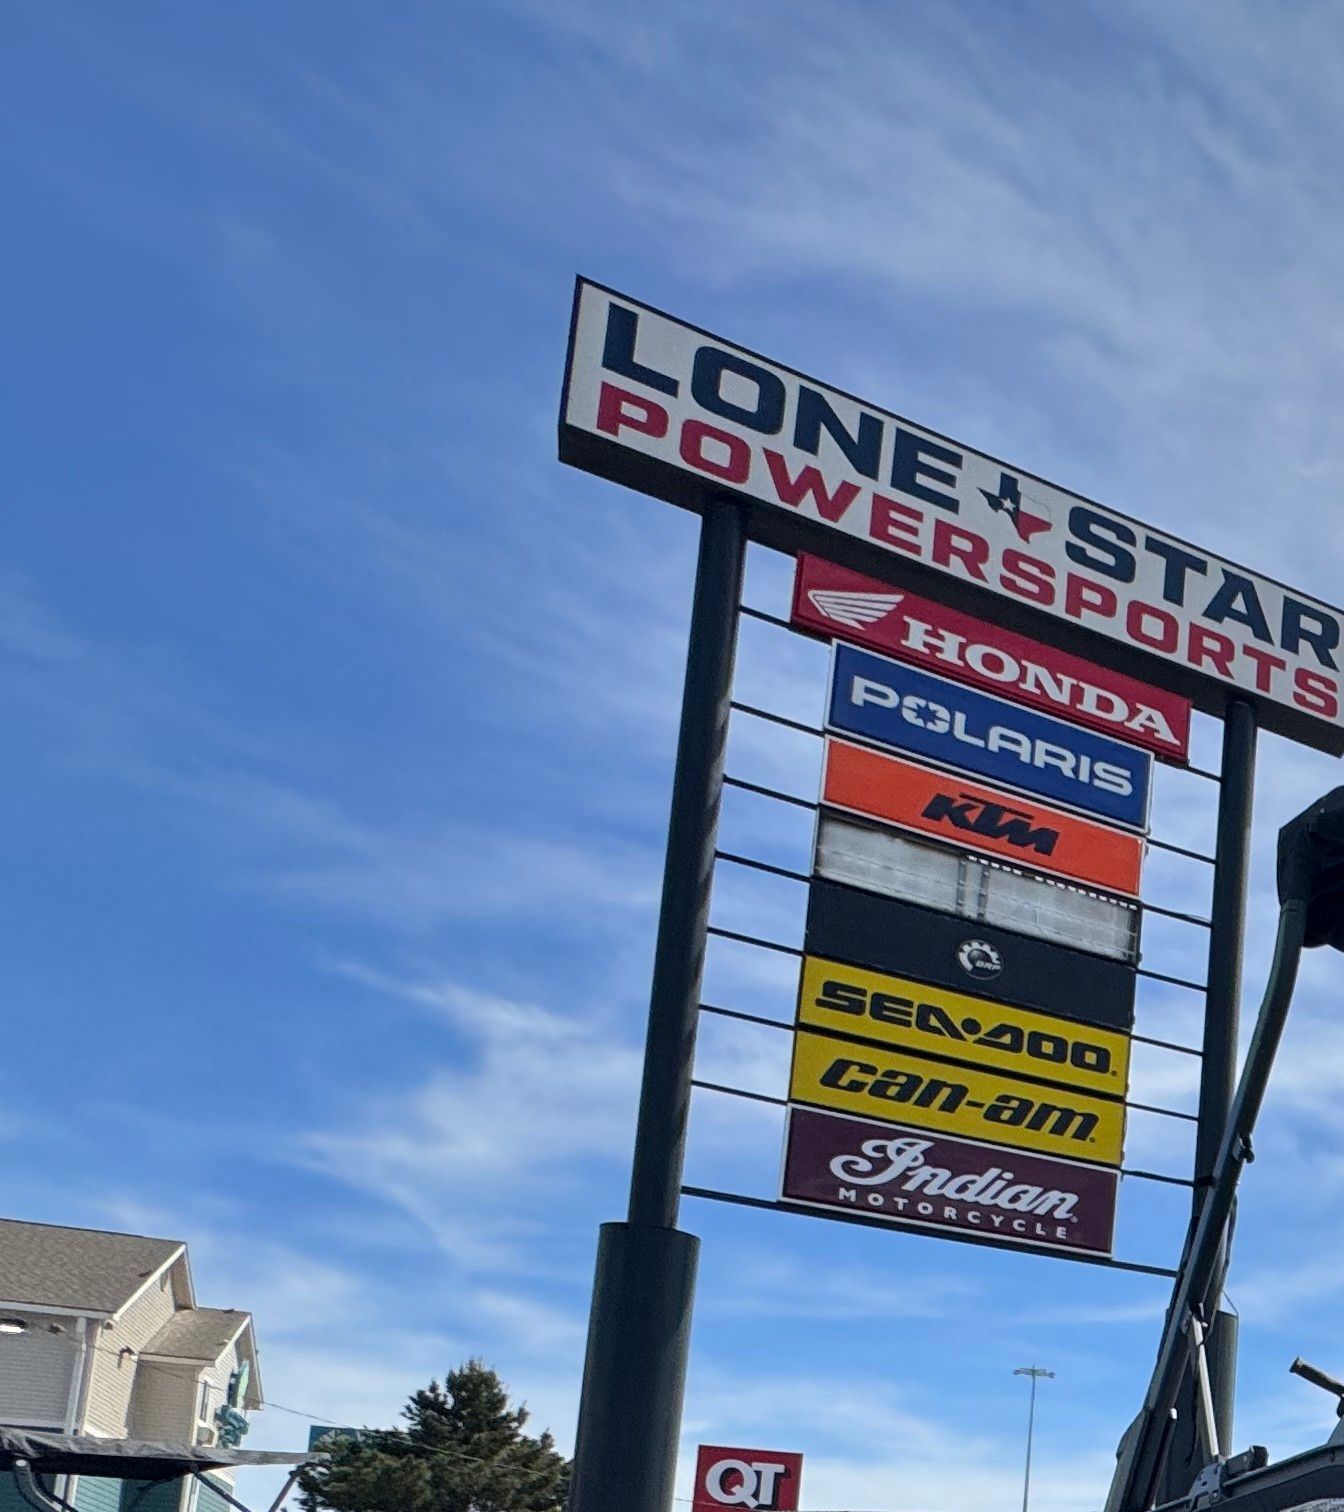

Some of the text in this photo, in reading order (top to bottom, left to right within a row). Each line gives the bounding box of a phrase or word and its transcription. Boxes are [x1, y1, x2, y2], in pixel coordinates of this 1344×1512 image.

[600, 302, 1341, 671] LONE STAR
[597, 382, 1339, 720] POWERSPORTS
[901, 615, 1181, 746] HONDA
[851, 675, 1134, 797] POLARIS
[921, 792, 1060, 856] KTM
[830, 1137, 1078, 1220] Indian
[838, 1187, 1068, 1239] MOTORCYCLE
[706, 1459, 785, 1508] QT
